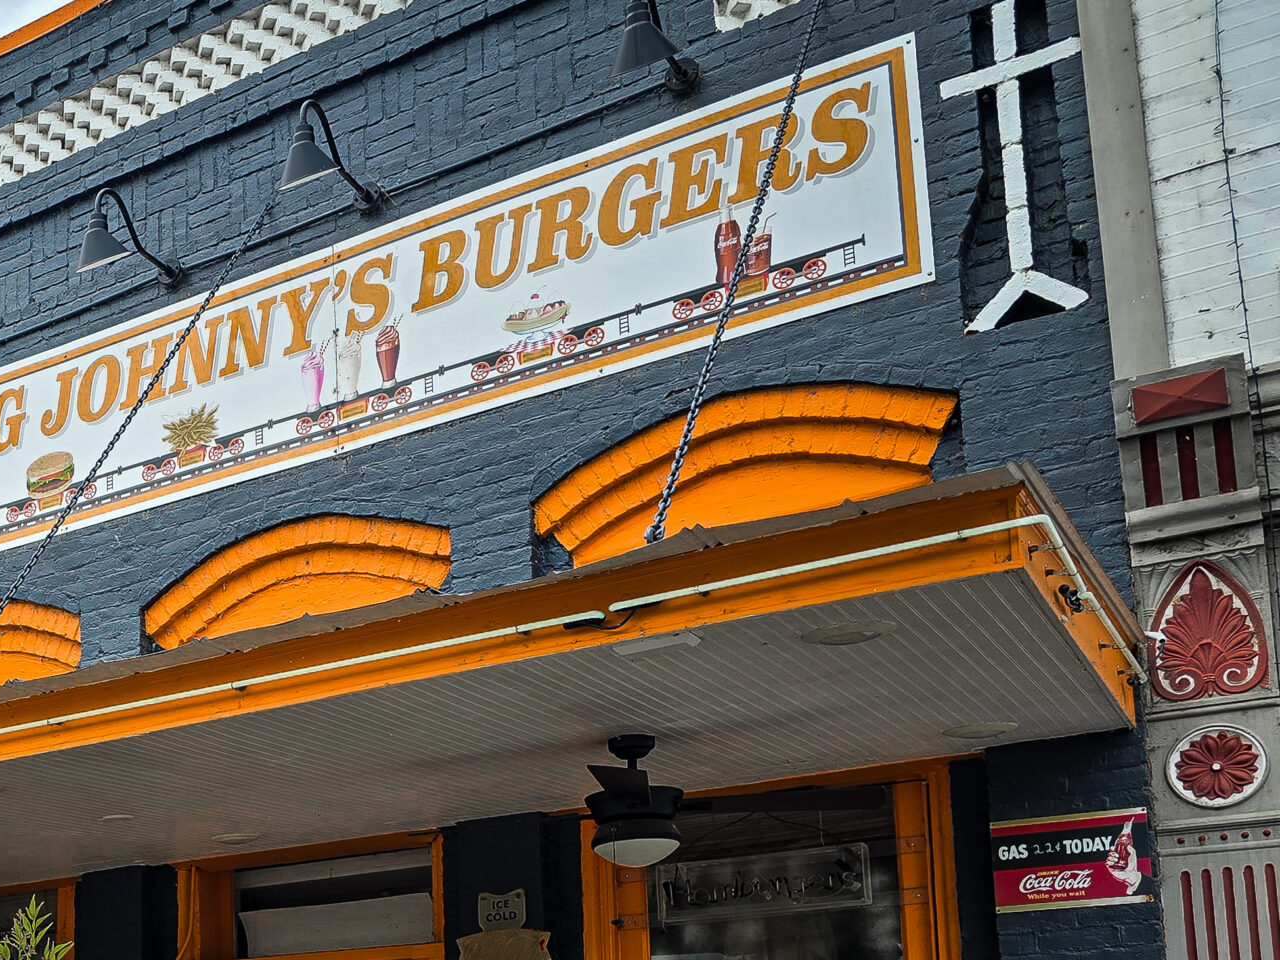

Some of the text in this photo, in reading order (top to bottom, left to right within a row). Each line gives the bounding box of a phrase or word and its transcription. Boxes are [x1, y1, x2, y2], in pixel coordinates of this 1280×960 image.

[41, 251, 394, 438] JOHNNY'S
[411, 81, 873, 313] BURGERS
[998, 844, 1029, 861] GAS
[1063, 836, 1113, 855] TODAY
[1019, 869, 1094, 894] Coca-Cola
[492, 899, 510, 910] ICE
[1027, 892, 1050, 900] While
[1052, 892, 1068, 900] you
[485, 910, 517, 922] COLD
